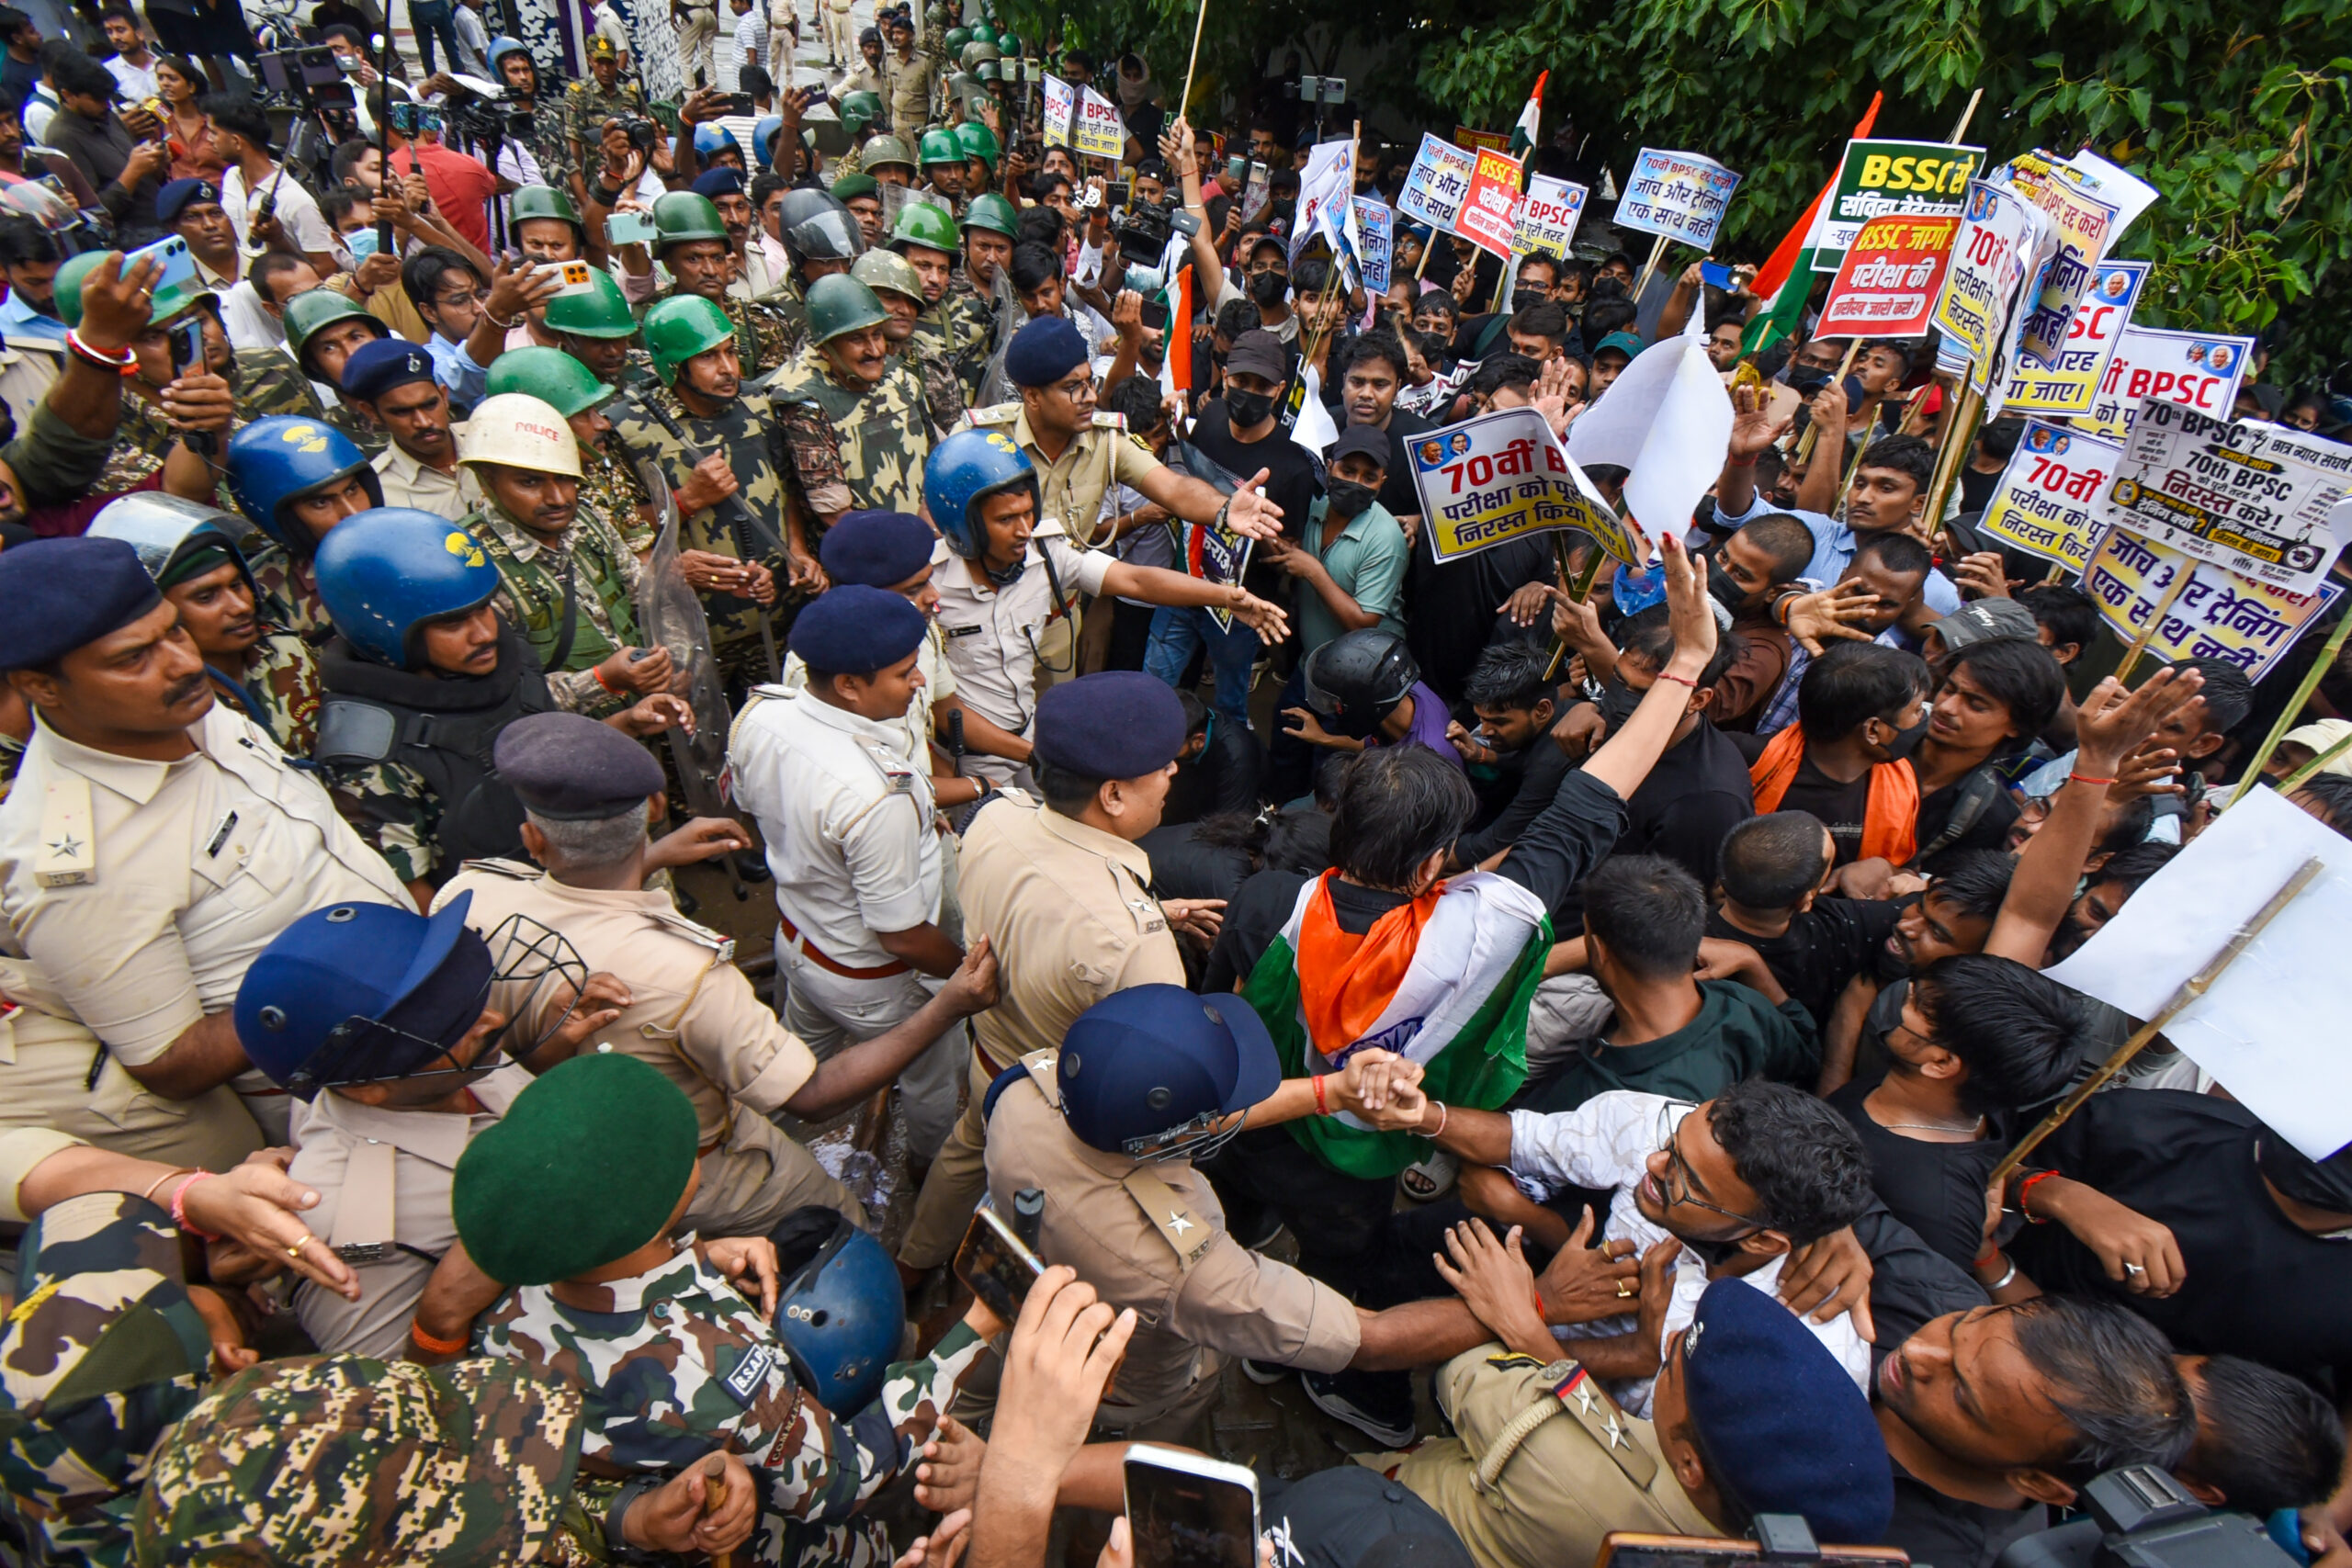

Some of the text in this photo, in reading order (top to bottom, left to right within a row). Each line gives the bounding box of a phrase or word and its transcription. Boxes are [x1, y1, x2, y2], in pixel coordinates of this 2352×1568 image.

[1087, 103, 1118, 122] BPSC
[1426, 142, 1444, 159] 70वीं
[1443, 154, 1467, 172] BPSC
[1478, 156, 1510, 184] BSSC
[1646, 157, 1672, 172] 70वीं
[1671, 162, 1698, 177] BPSC
[1859, 154, 1954, 193] BSSC
[1415, 163, 1437, 184] जांच
[1435, 171, 1461, 197] और
[1634, 175, 1724, 215] जांच और ट्रेनिंग
[1407, 186, 1456, 221] एक साथ
[1477, 186, 1512, 215] परीक्षा
[1529, 200, 1572, 227] BPSC
[1544, 228, 1566, 243] तरह
[1627, 201, 1716, 238] एक साथ नहीं
[1855, 224, 1908, 252] BSSC
[1905, 219, 1953, 251] जागो
[2078, 210, 2106, 241] करो
[1849, 255, 1936, 288] परीक्षा की
[1867, 298, 1894, 316] जारी
[2031, 379, 2085, 402] जाए।
[2127, 368, 2221, 409] BPSC
[2096, 400, 2119, 423] को
[515, 422, 559, 442] POLICE
[2180, 412, 2247, 449] BPSC
[1441, 438, 1537, 494] 70वीं
[2270, 439, 2293, 456] छात्र
[2293, 445, 2321, 465] न्याय
[2027, 456, 2109, 503] 70वीं
[2161, 468, 2238, 514] निरस्त
[2185, 450, 2293, 502] 70th BPSC
[1442, 486, 1511, 521] परीक्षा
[1517, 475, 1548, 500] को
[2010, 487, 2063, 521] परीक्षा
[2063, 509, 2088, 530] को
[1453, 508, 1526, 546] निरस्त
[1533, 501, 1587, 524] किया
[1999, 510, 2058, 547] निरस्त
[2092, 566, 2134, 606] एक
[2107, 533, 2160, 577] जांच
[2204, 588, 2293, 647] ट्रेनिंग
